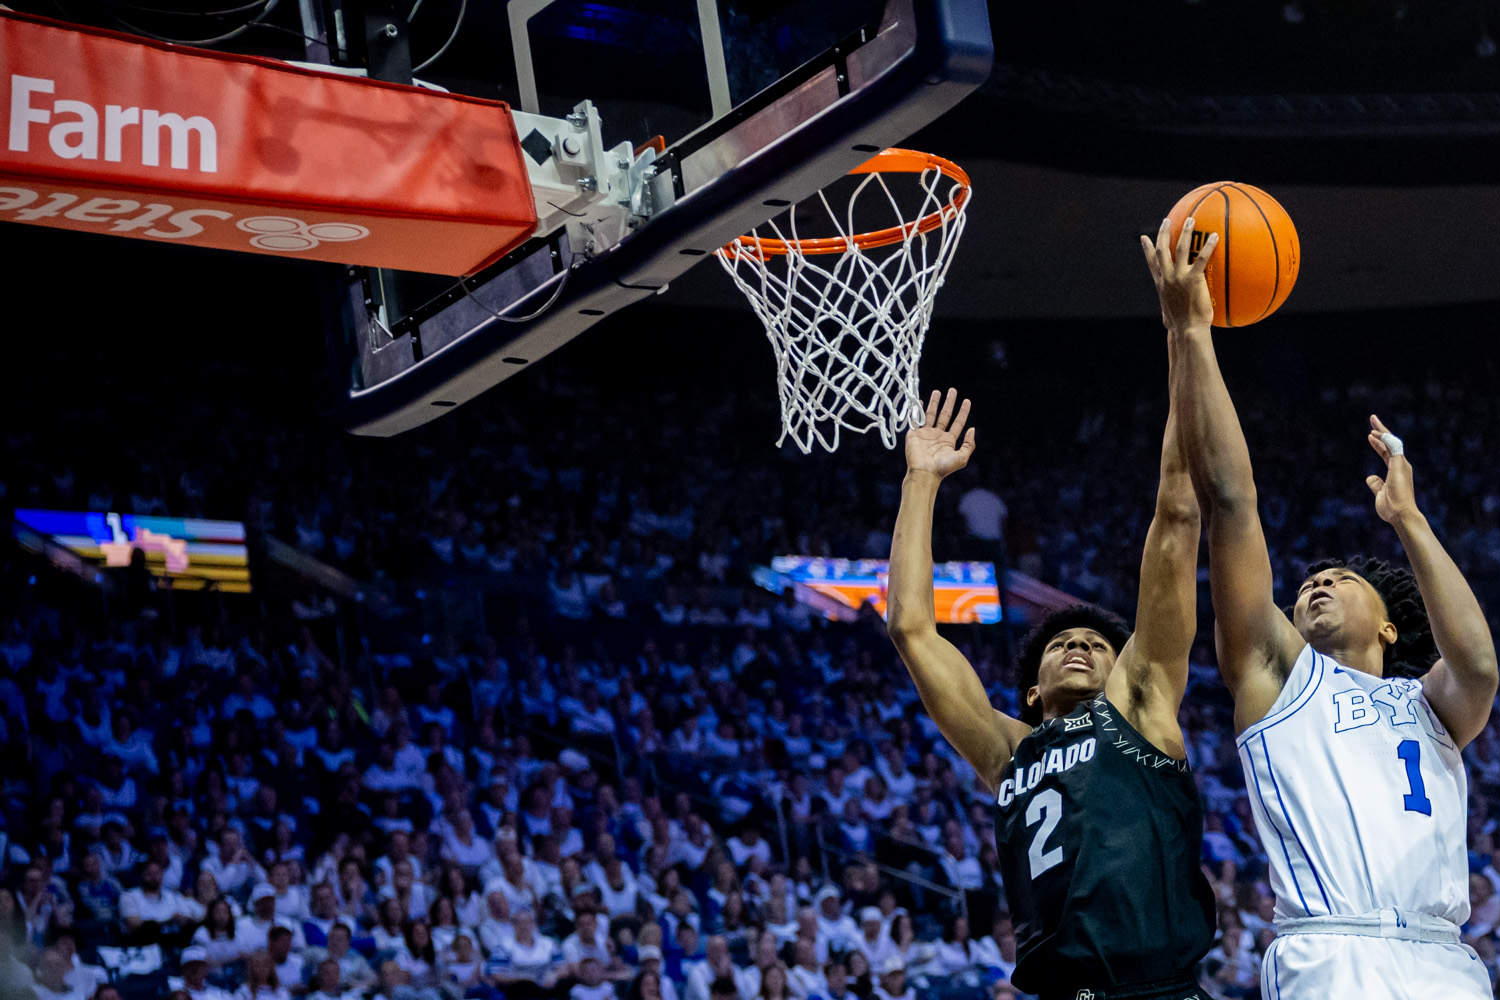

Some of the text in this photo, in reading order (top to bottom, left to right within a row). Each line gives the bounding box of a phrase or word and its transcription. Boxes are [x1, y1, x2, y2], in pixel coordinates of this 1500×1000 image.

[9, 74, 217, 173] Farm
[1397, 739, 1431, 817] 1
[1026, 788, 1063, 880] 2
